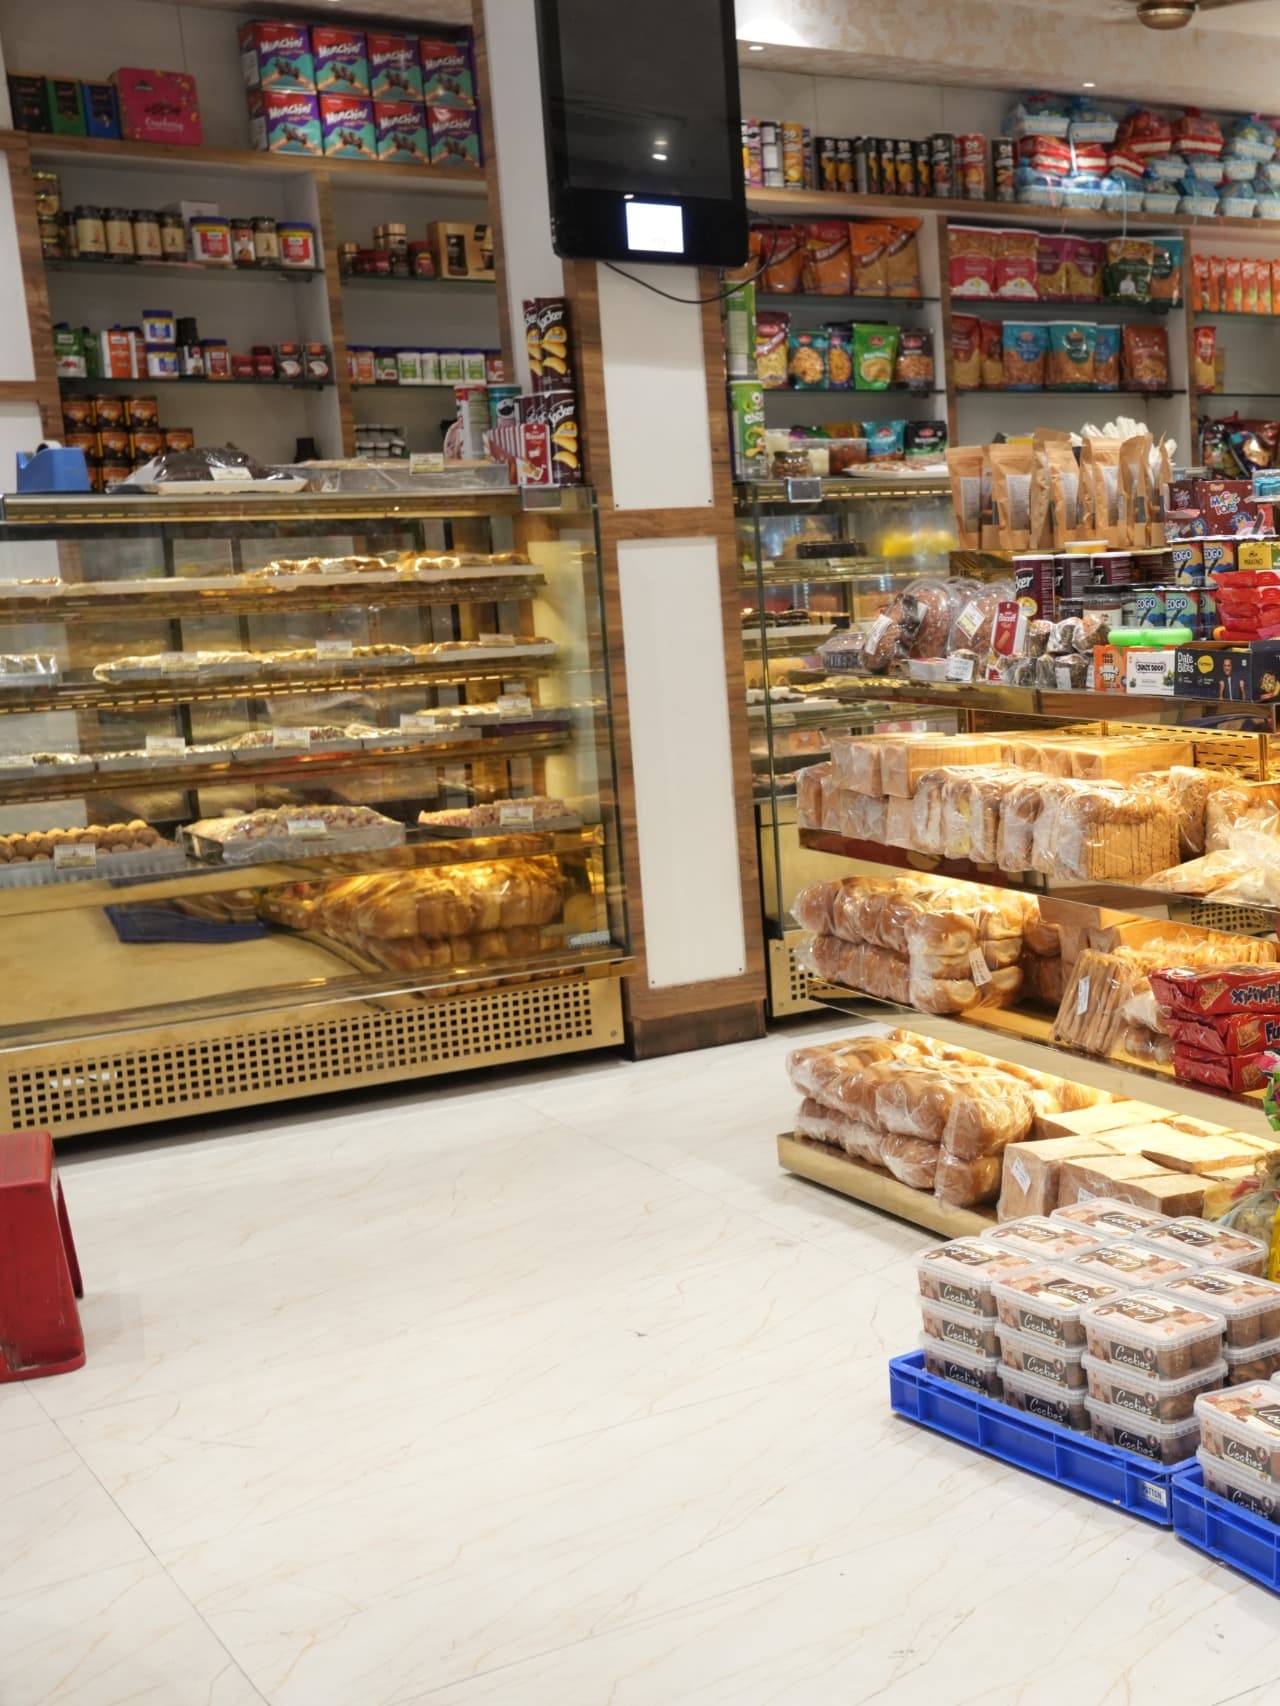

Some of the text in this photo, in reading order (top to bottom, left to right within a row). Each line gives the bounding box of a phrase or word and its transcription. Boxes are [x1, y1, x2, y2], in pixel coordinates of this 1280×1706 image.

[1177, 652, 1194, 663] Date
[943, 1286, 976, 1308] Cookies
[946, 1324, 979, 1346] Cookies
[1023, 1314, 1058, 1338] Cookies
[1027, 1357, 1061, 1381] Cookies
[1115, 1346, 1150, 1370] Cookies
[949, 1364, 981, 1387] Cookies
[1029, 1398, 1064, 1422] Cookies
[1116, 1390, 1153, 1415] Cookies
[1118, 1432, 1154, 1457] Cookies
[1227, 1441, 1263, 1471] Cookies
